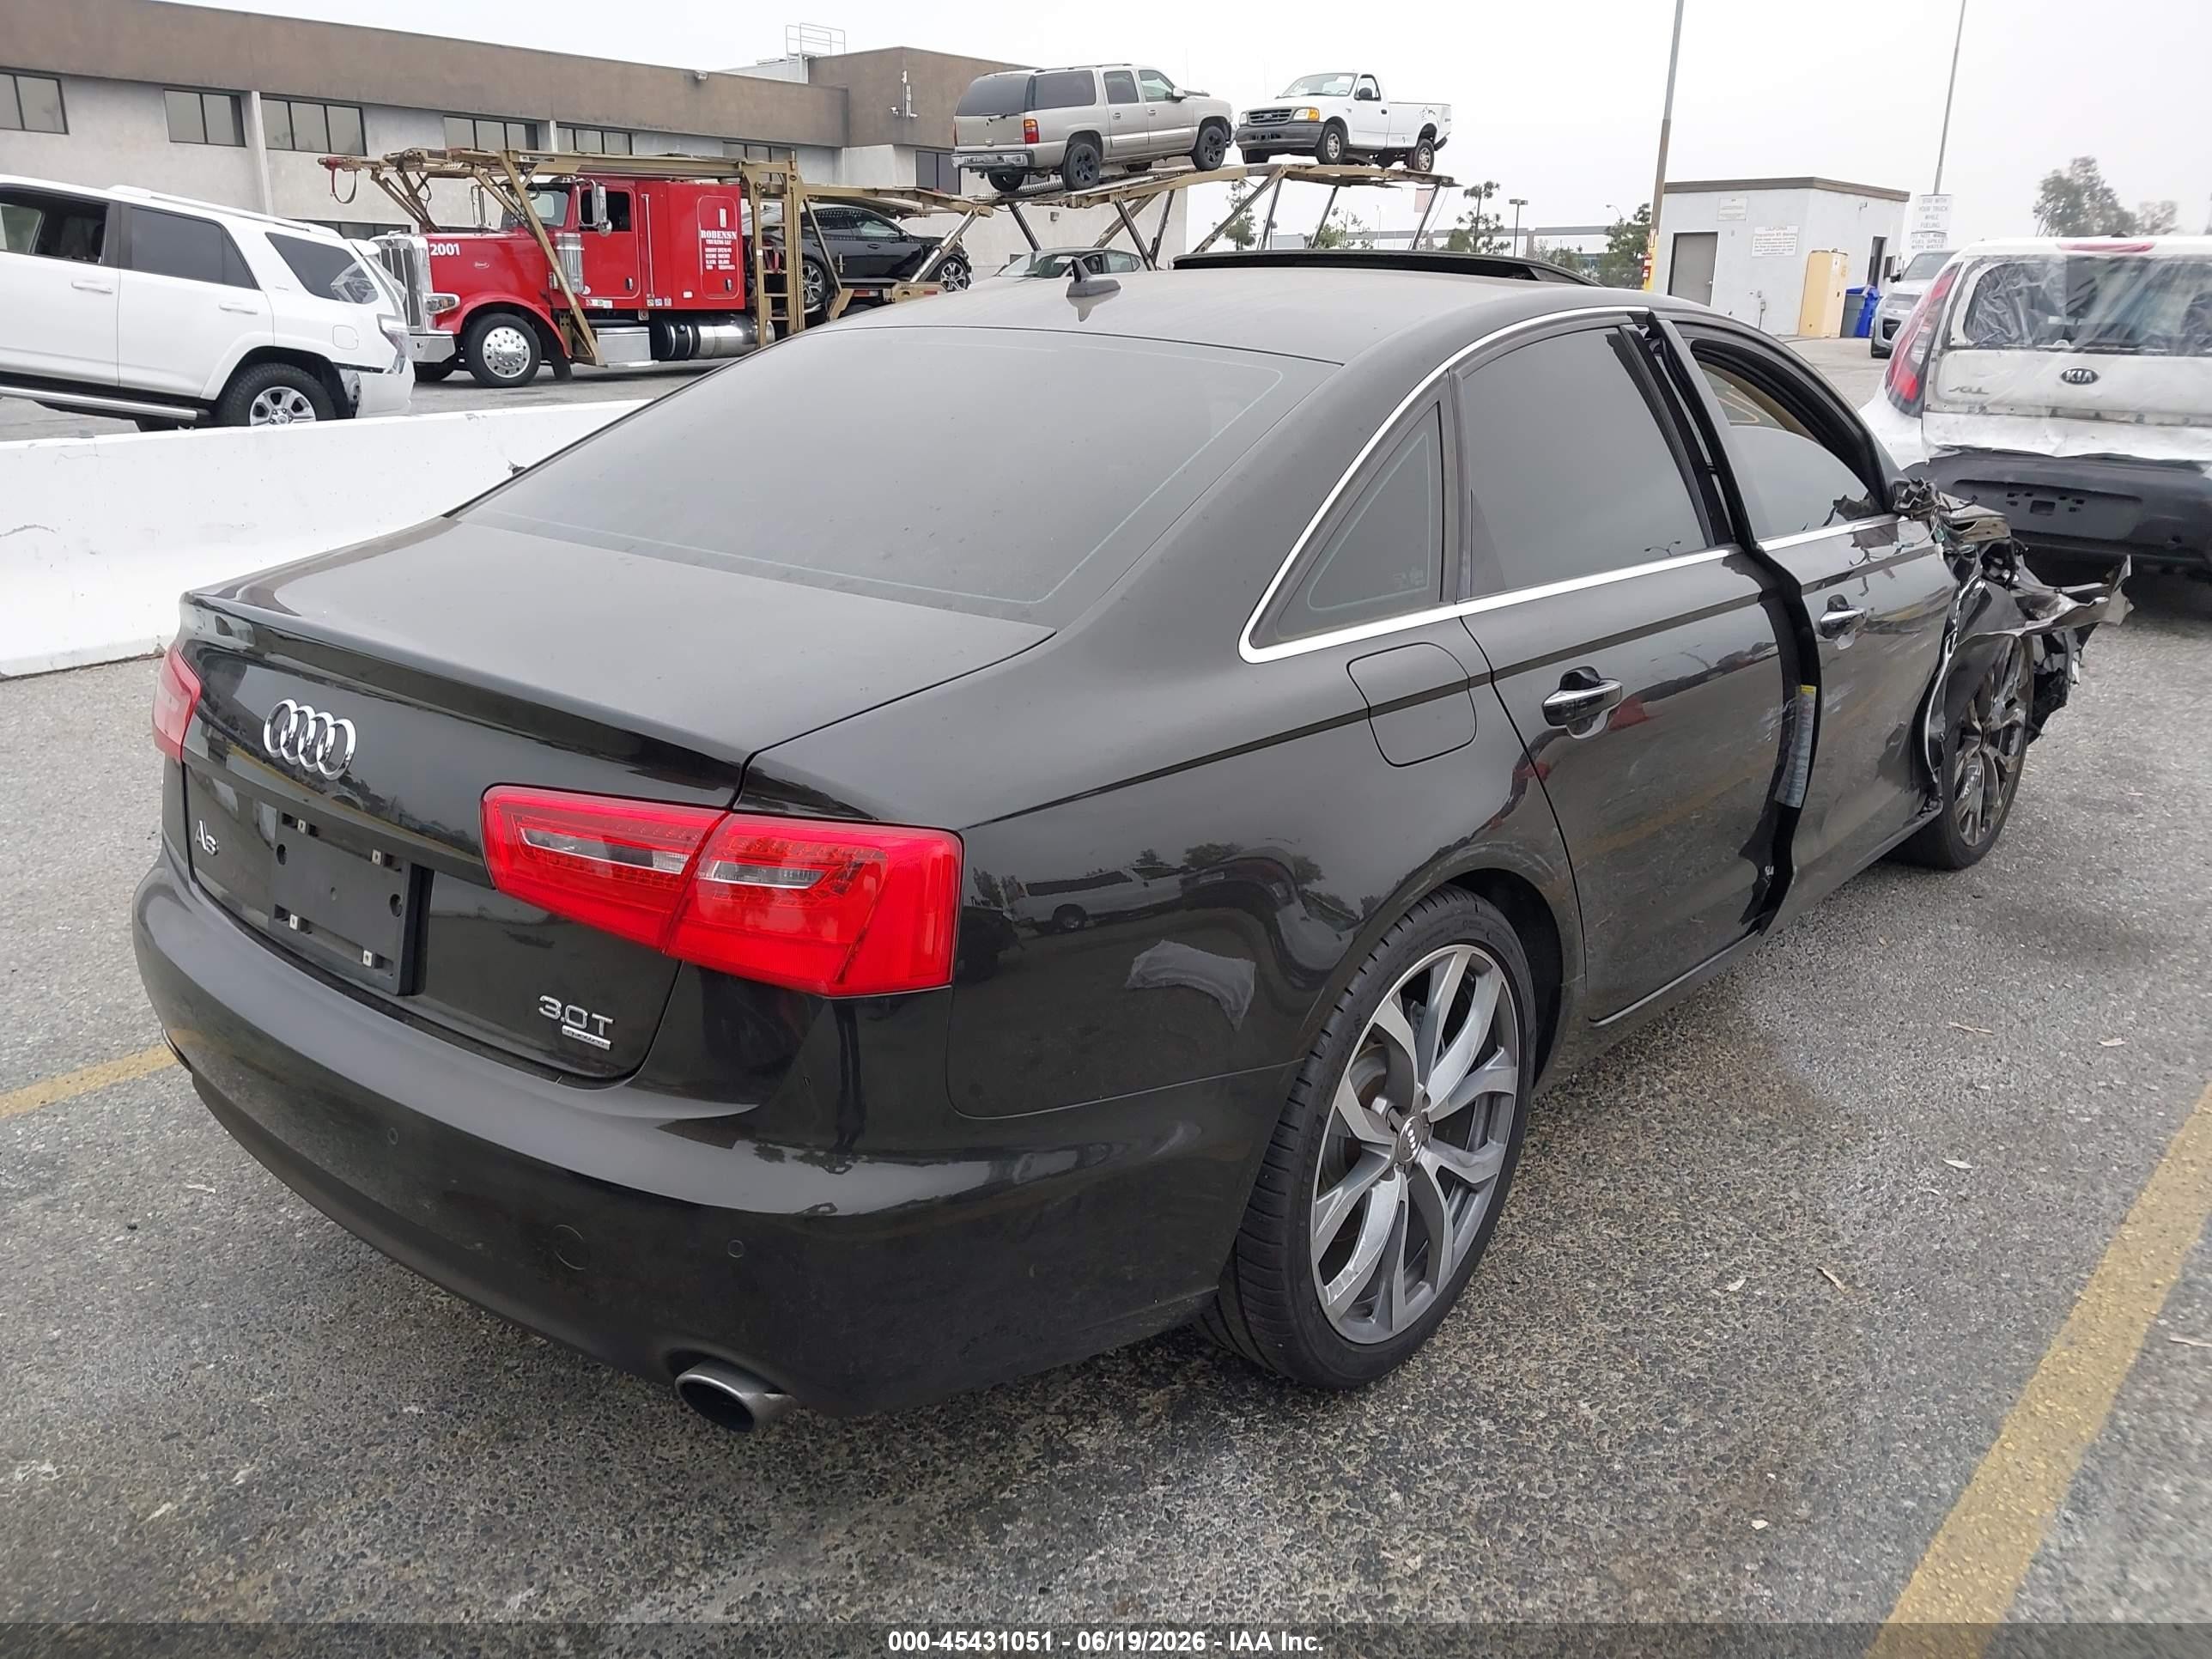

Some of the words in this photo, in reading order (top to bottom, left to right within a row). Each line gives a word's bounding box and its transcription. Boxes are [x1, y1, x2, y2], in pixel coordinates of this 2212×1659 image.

[429, 242, 460, 256] 2001
[2065, 370, 2094, 382] KIA
[538, 995, 614, 1037] 3.0T
